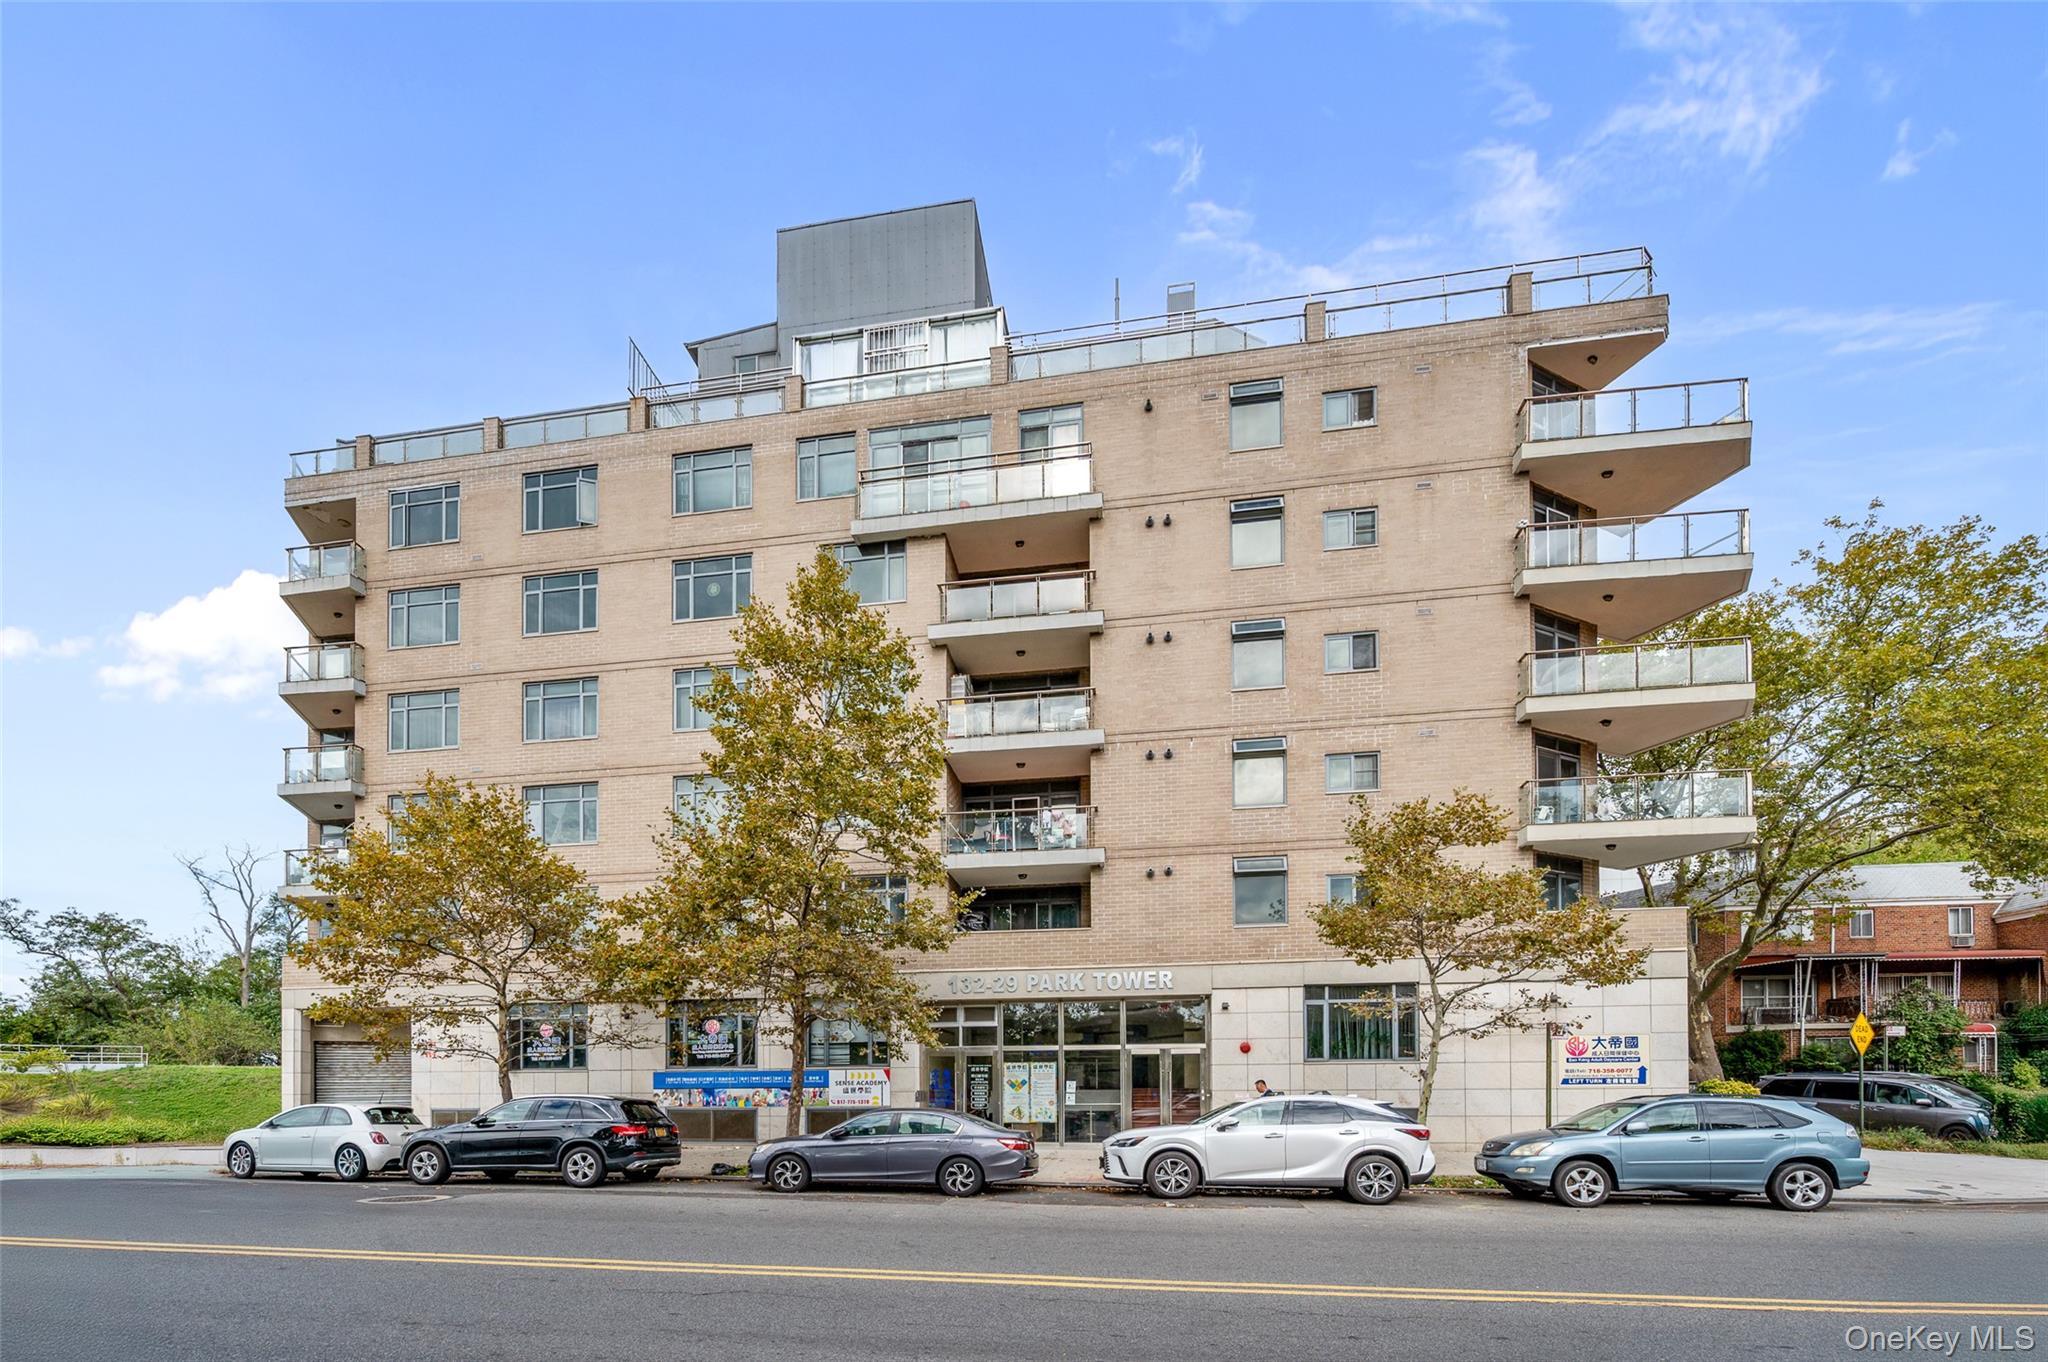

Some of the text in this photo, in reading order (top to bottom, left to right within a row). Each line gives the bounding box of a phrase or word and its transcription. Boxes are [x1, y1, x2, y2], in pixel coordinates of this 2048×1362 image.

[948, 970, 1174, 994] 132-29 PARK TOWER
[1855, 1024, 1869, 1033] DEAD
[1591, 1036, 1639, 1050] 大帝國
[1857, 1036, 1867, 1044] END
